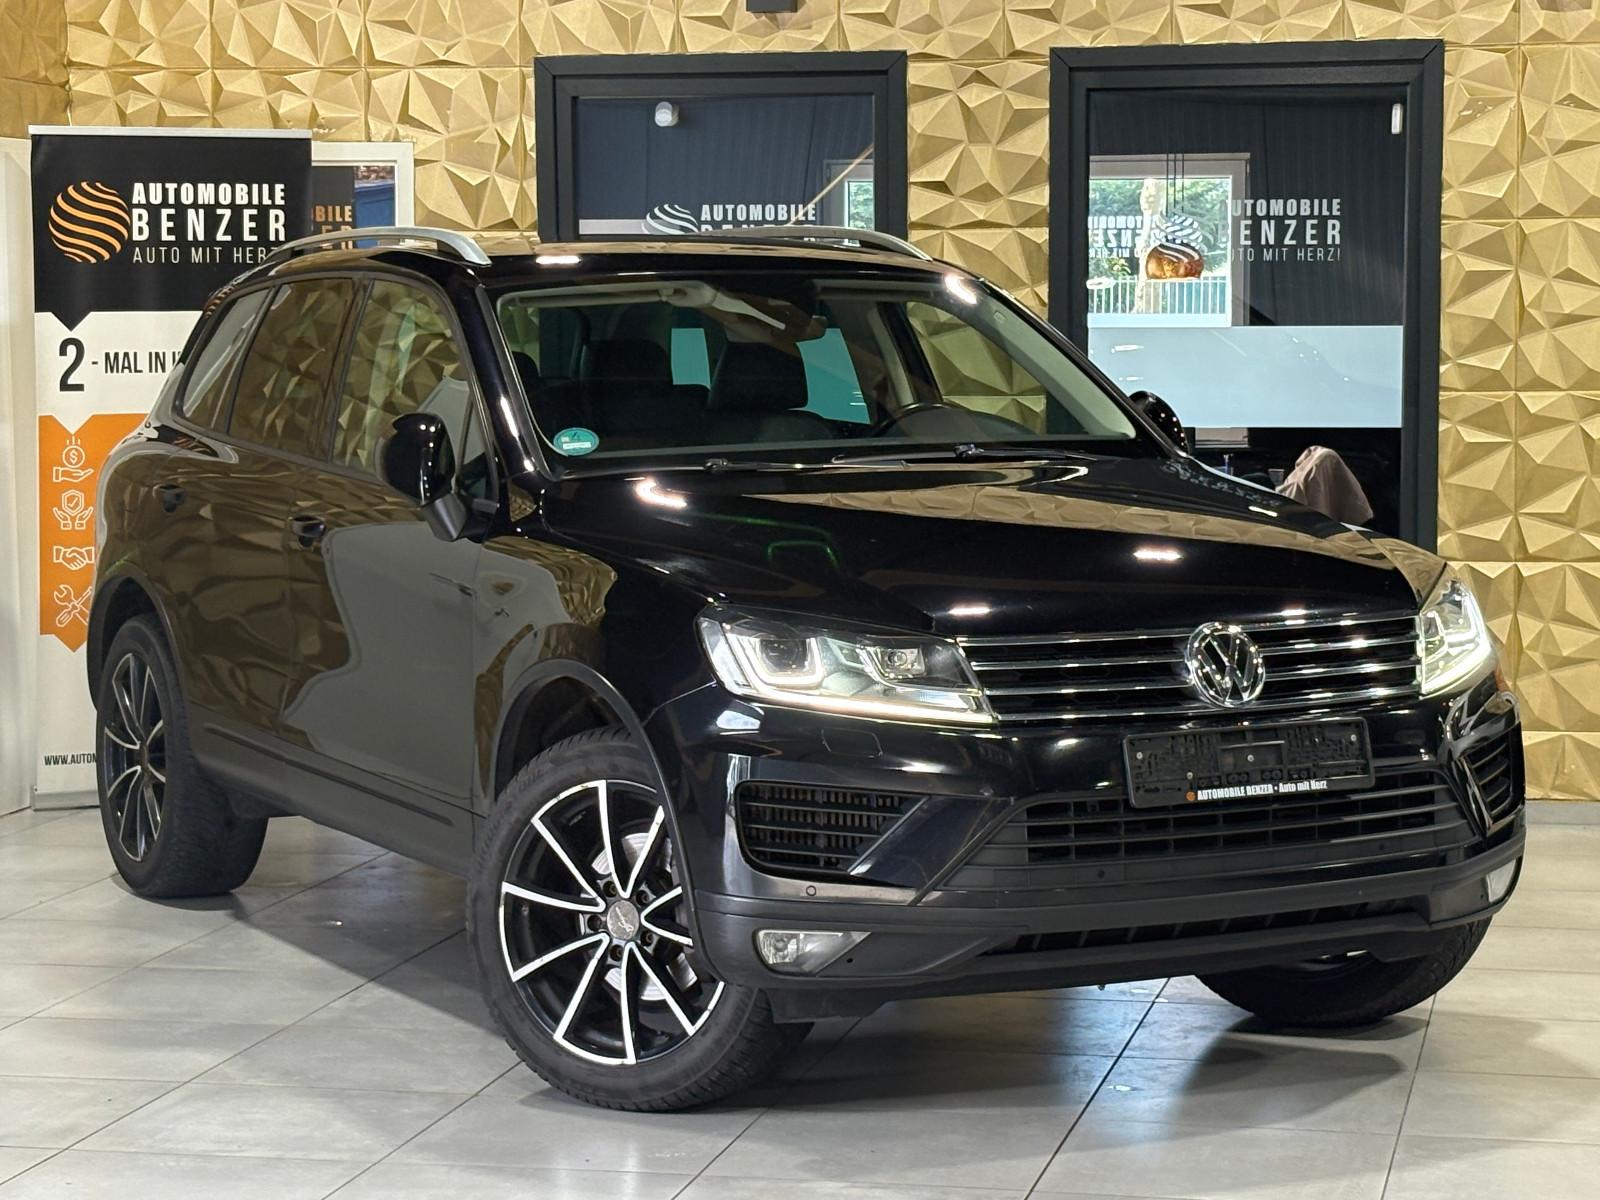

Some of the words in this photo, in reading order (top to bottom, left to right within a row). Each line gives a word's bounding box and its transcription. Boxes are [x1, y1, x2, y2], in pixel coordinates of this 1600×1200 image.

[132, 182, 286, 205] AUTOMOBILE
[311, 205, 353, 222] BILE
[700, 204, 816, 221] AUTOMOBILE
[1222, 198, 1342, 216] UTOMOBILE
[132, 208, 286, 241] BENZER
[132, 247, 180, 264] AUTO
[191, 247, 223, 264] MIT
[233, 247, 277, 264] HER
[1263, 248, 1289, 262] MIT
[59, 337, 85, 392] 2
[104, 351, 144, 374] MAL
[148, 351, 167, 373] IN
[1197, 786, 1246, 800] AUTOMOBILE
